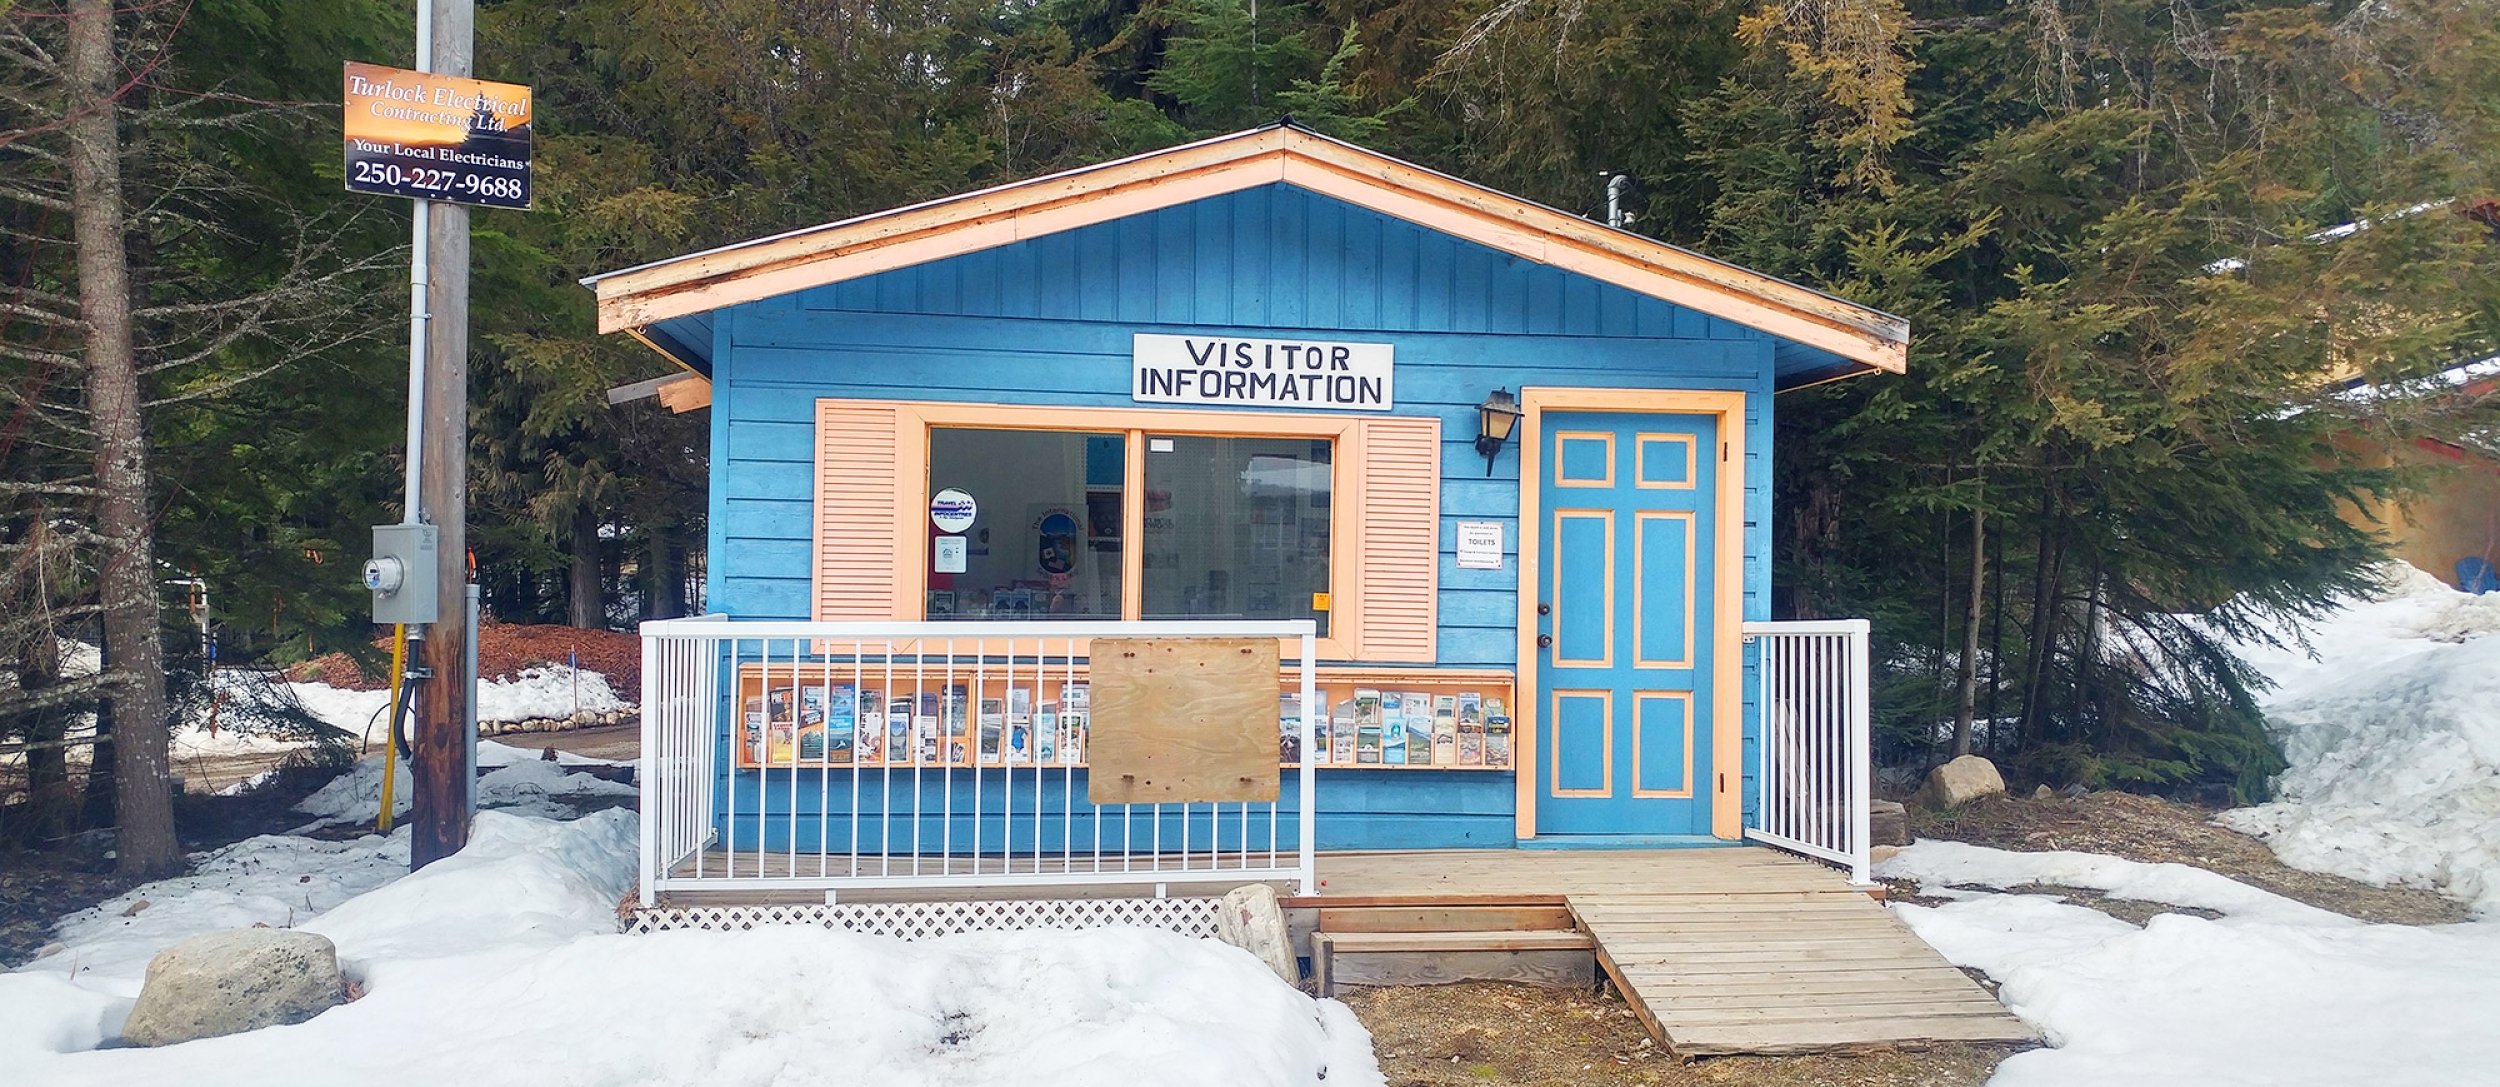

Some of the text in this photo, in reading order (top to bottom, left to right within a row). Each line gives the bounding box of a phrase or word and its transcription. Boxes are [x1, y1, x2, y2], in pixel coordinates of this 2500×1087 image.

[349, 75, 527, 116] Turlock Electrical
[370, 101, 509, 132] Contracting Ltd.
[353, 138, 524, 170] Your Local Electricians
[354, 161, 523, 199] 250-227-9688
[1185, 339, 1350, 371] VISITOR
[1140, 367, 1382, 404] INFORMATION
[1468, 538, 1496, 546] TOILETS
